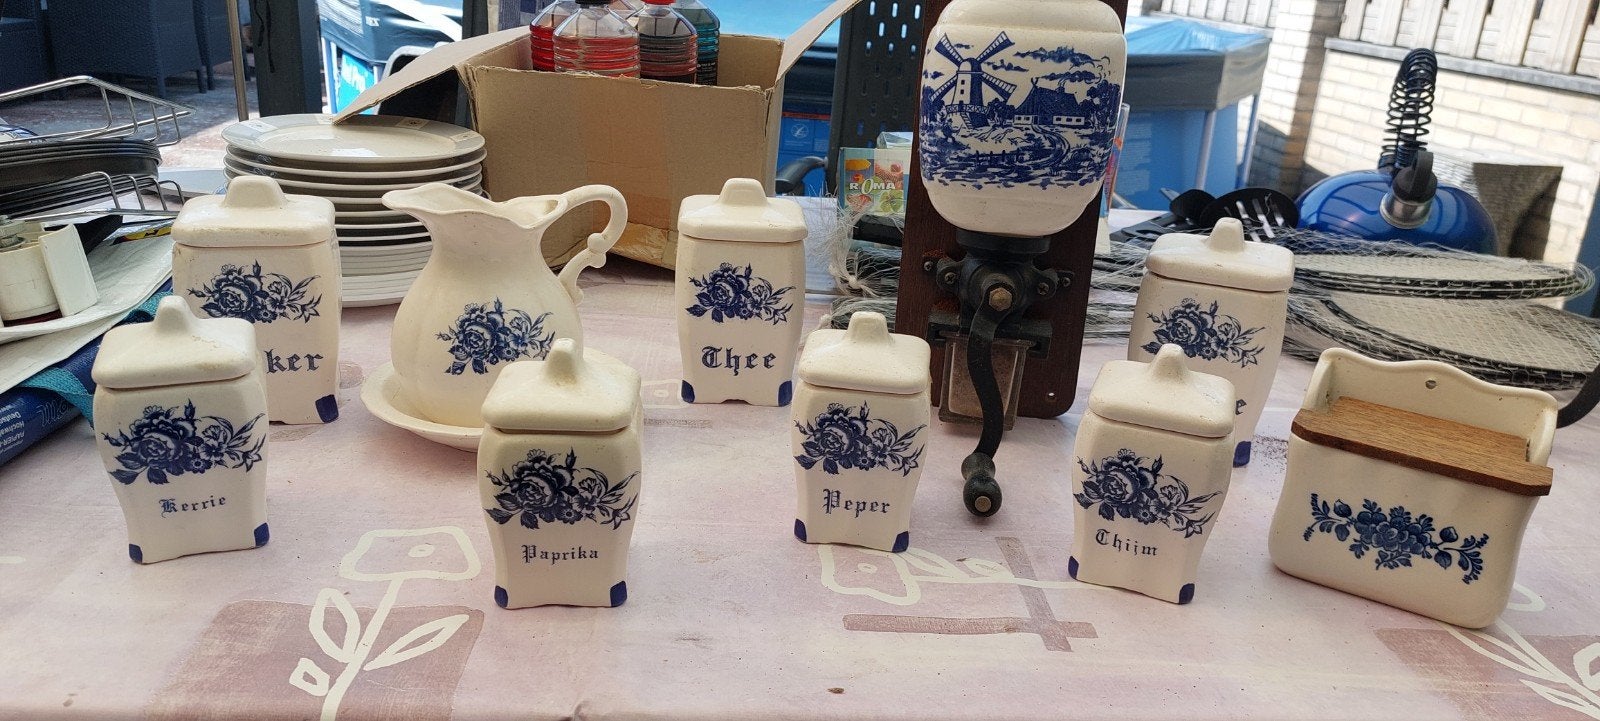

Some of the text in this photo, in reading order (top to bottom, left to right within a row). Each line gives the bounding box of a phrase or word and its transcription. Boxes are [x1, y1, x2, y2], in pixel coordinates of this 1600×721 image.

[849, 178, 896, 195] ROMA
[264, 348, 324, 374] ker
[701, 345, 777, 377] Thee
[158, 495, 226, 518] Kerrie
[822, 488, 890, 519] Peper
[521, 544, 599, 566] Paprika
[1095, 528, 1158, 556] Thijm
